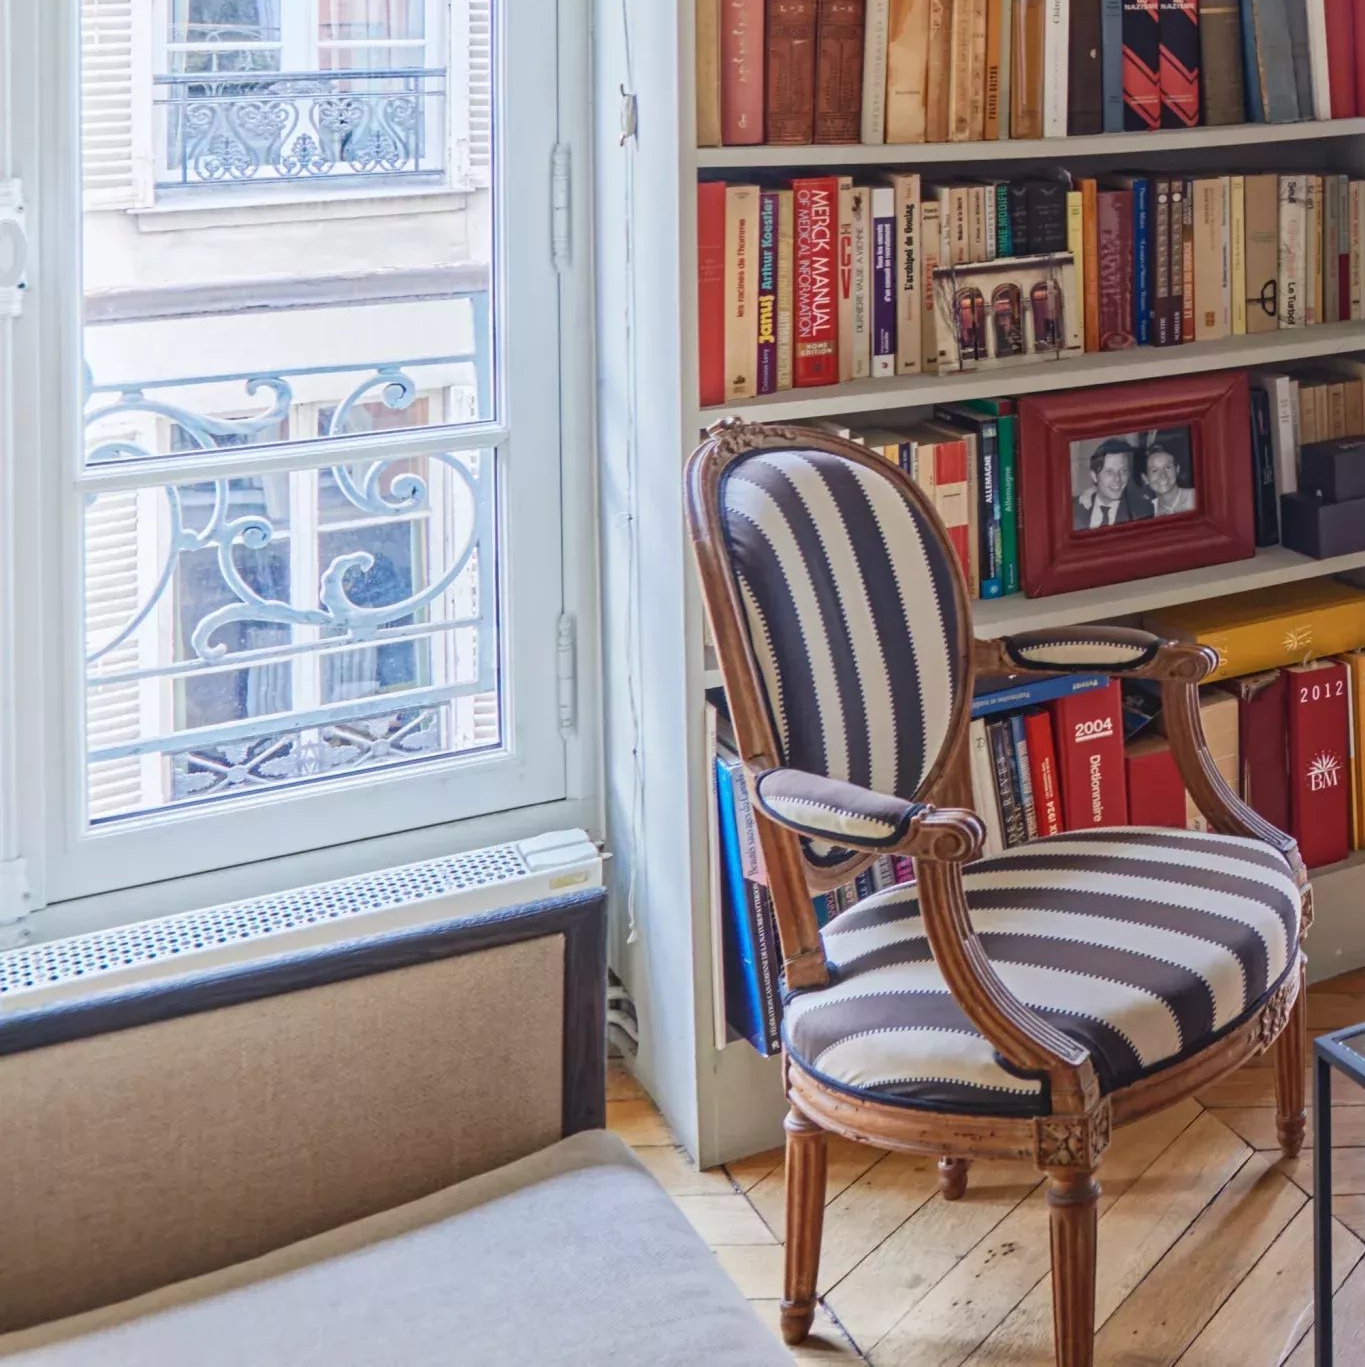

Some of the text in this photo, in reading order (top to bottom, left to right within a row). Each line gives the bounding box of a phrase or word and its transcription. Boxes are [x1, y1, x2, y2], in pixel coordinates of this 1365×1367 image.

[1124, 3, 1158, 11] NAZISME
[1160, 3, 1195, 11] NAZISME
[761, 198, 774, 247] Koestler
[996, 186, 1008, 226] MODIFIE
[736, 219, 746, 318] les racines de l'homme
[761, 249, 773, 290] Arthur
[797, 189, 811, 338] OF MEDICAL INFORMATION
[811, 189, 831, 337] MERCK MANUAL
[904, 204, 915, 291] L'archipel du Goulag
[1287, 181, 1297, 325] Seuil Le Turbot
[757, 294, 775, 344] Janus
[801, 348, 832, 357] EDITION
[805, 342, 828, 350] HOME
[984, 454, 994, 503] ALLEMAGNE
[1003, 466, 1015, 513] Allemagne
[1299, 680, 1344, 703] 2012
[1074, 717, 1113, 737] 2004
[1089, 754, 1103, 823] Dictionnaire
[1310, 769, 1339, 791] BM
[1046, 801, 1057, 823] 1924
